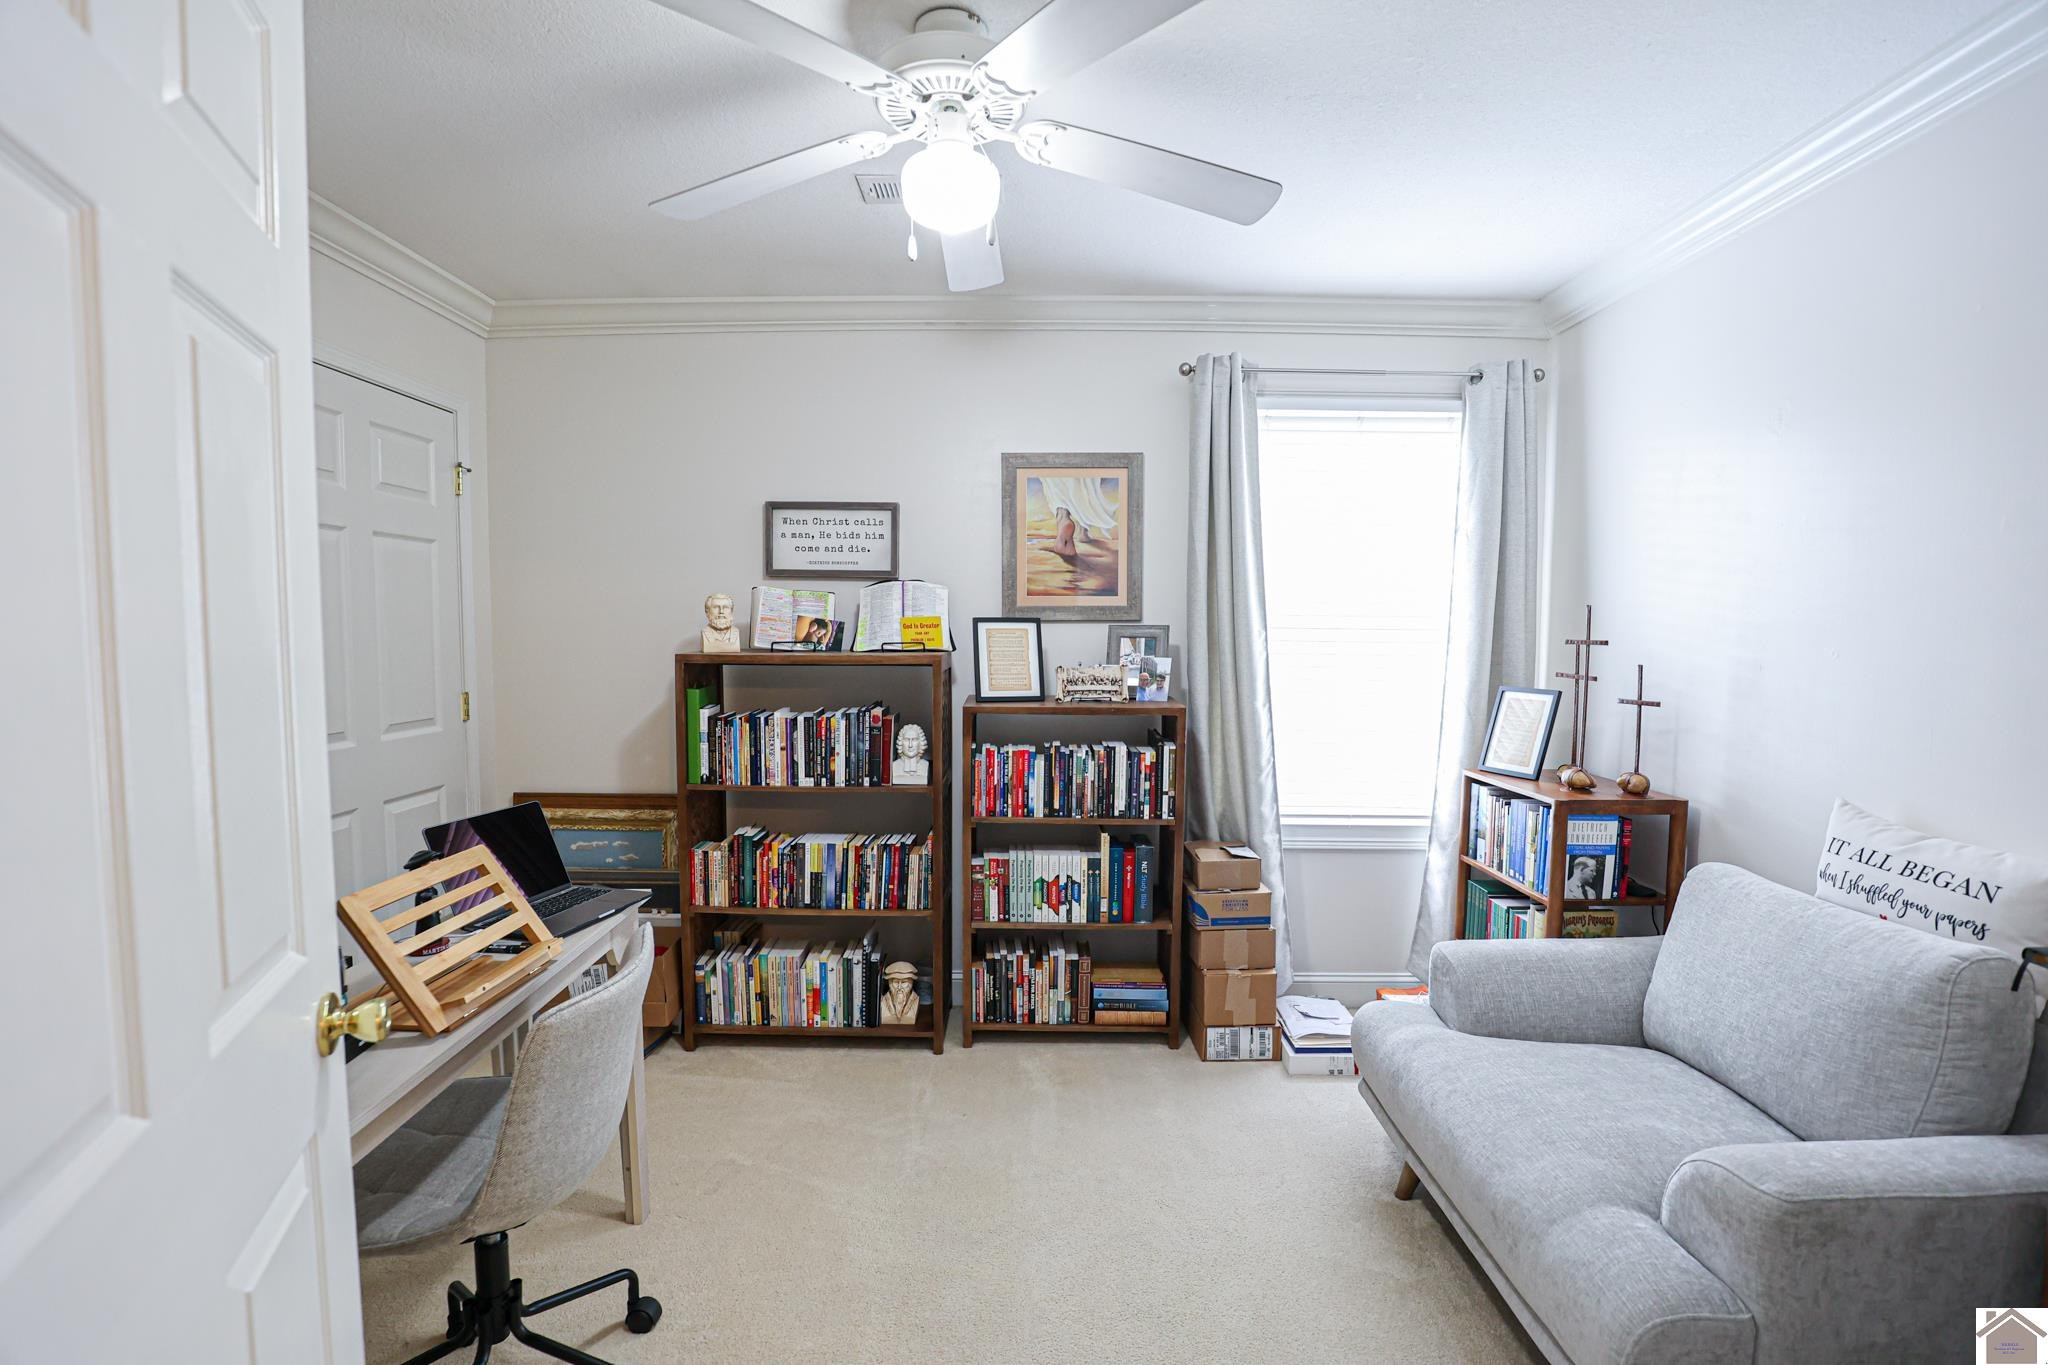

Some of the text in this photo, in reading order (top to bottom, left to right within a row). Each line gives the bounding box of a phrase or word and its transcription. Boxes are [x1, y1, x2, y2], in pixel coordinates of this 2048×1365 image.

[782, 517, 884, 526] When Christ calls
[780, 531, 885, 540] a man, He bids him
[794, 544, 871, 553] come and die.
[1572, 822, 1608, 833] DIETRICH
[1827, 836, 2003, 904] IT ALL BEGAN
[1140, 874, 1148, 892] Study
[1819, 862, 1991, 941] when I shuffled your papers
